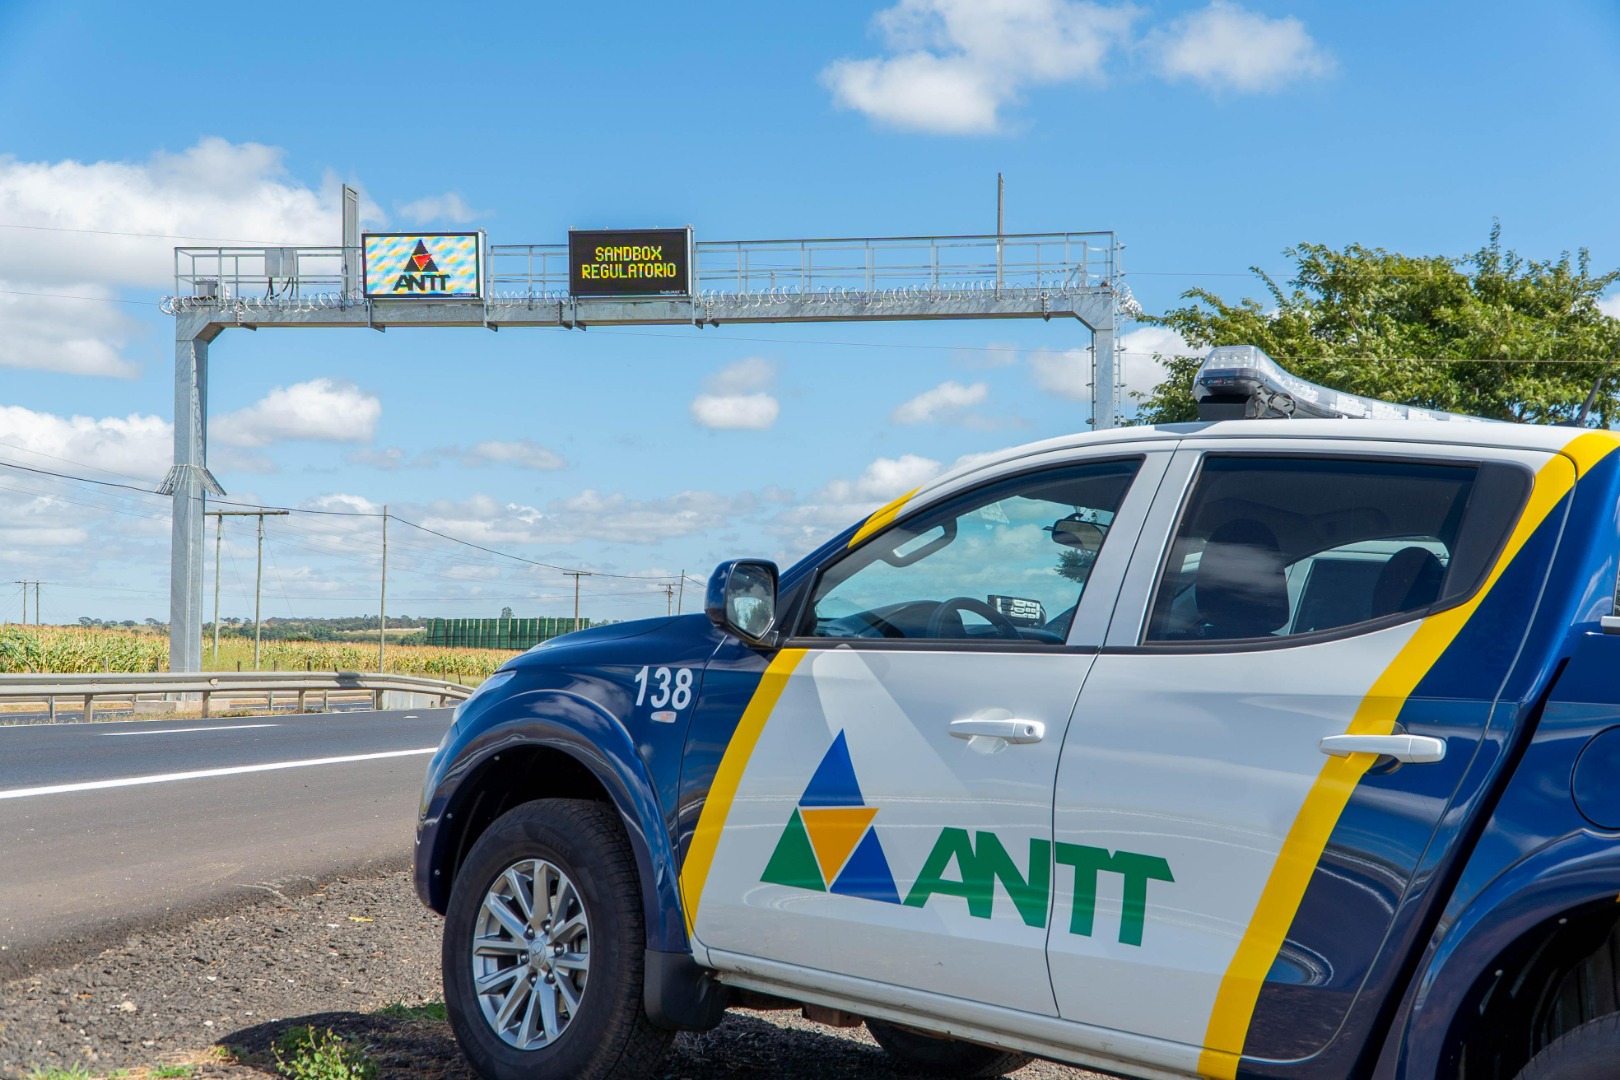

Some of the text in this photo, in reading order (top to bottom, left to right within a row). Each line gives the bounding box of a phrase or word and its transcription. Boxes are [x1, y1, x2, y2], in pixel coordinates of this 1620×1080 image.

[595, 246, 662, 261] SANDBOX
[581, 263, 677, 278] REGULATORIO
[393, 274, 451, 291] ANTT
[634, 665, 693, 710] 138
[902, 826, 1175, 947] ANTT
